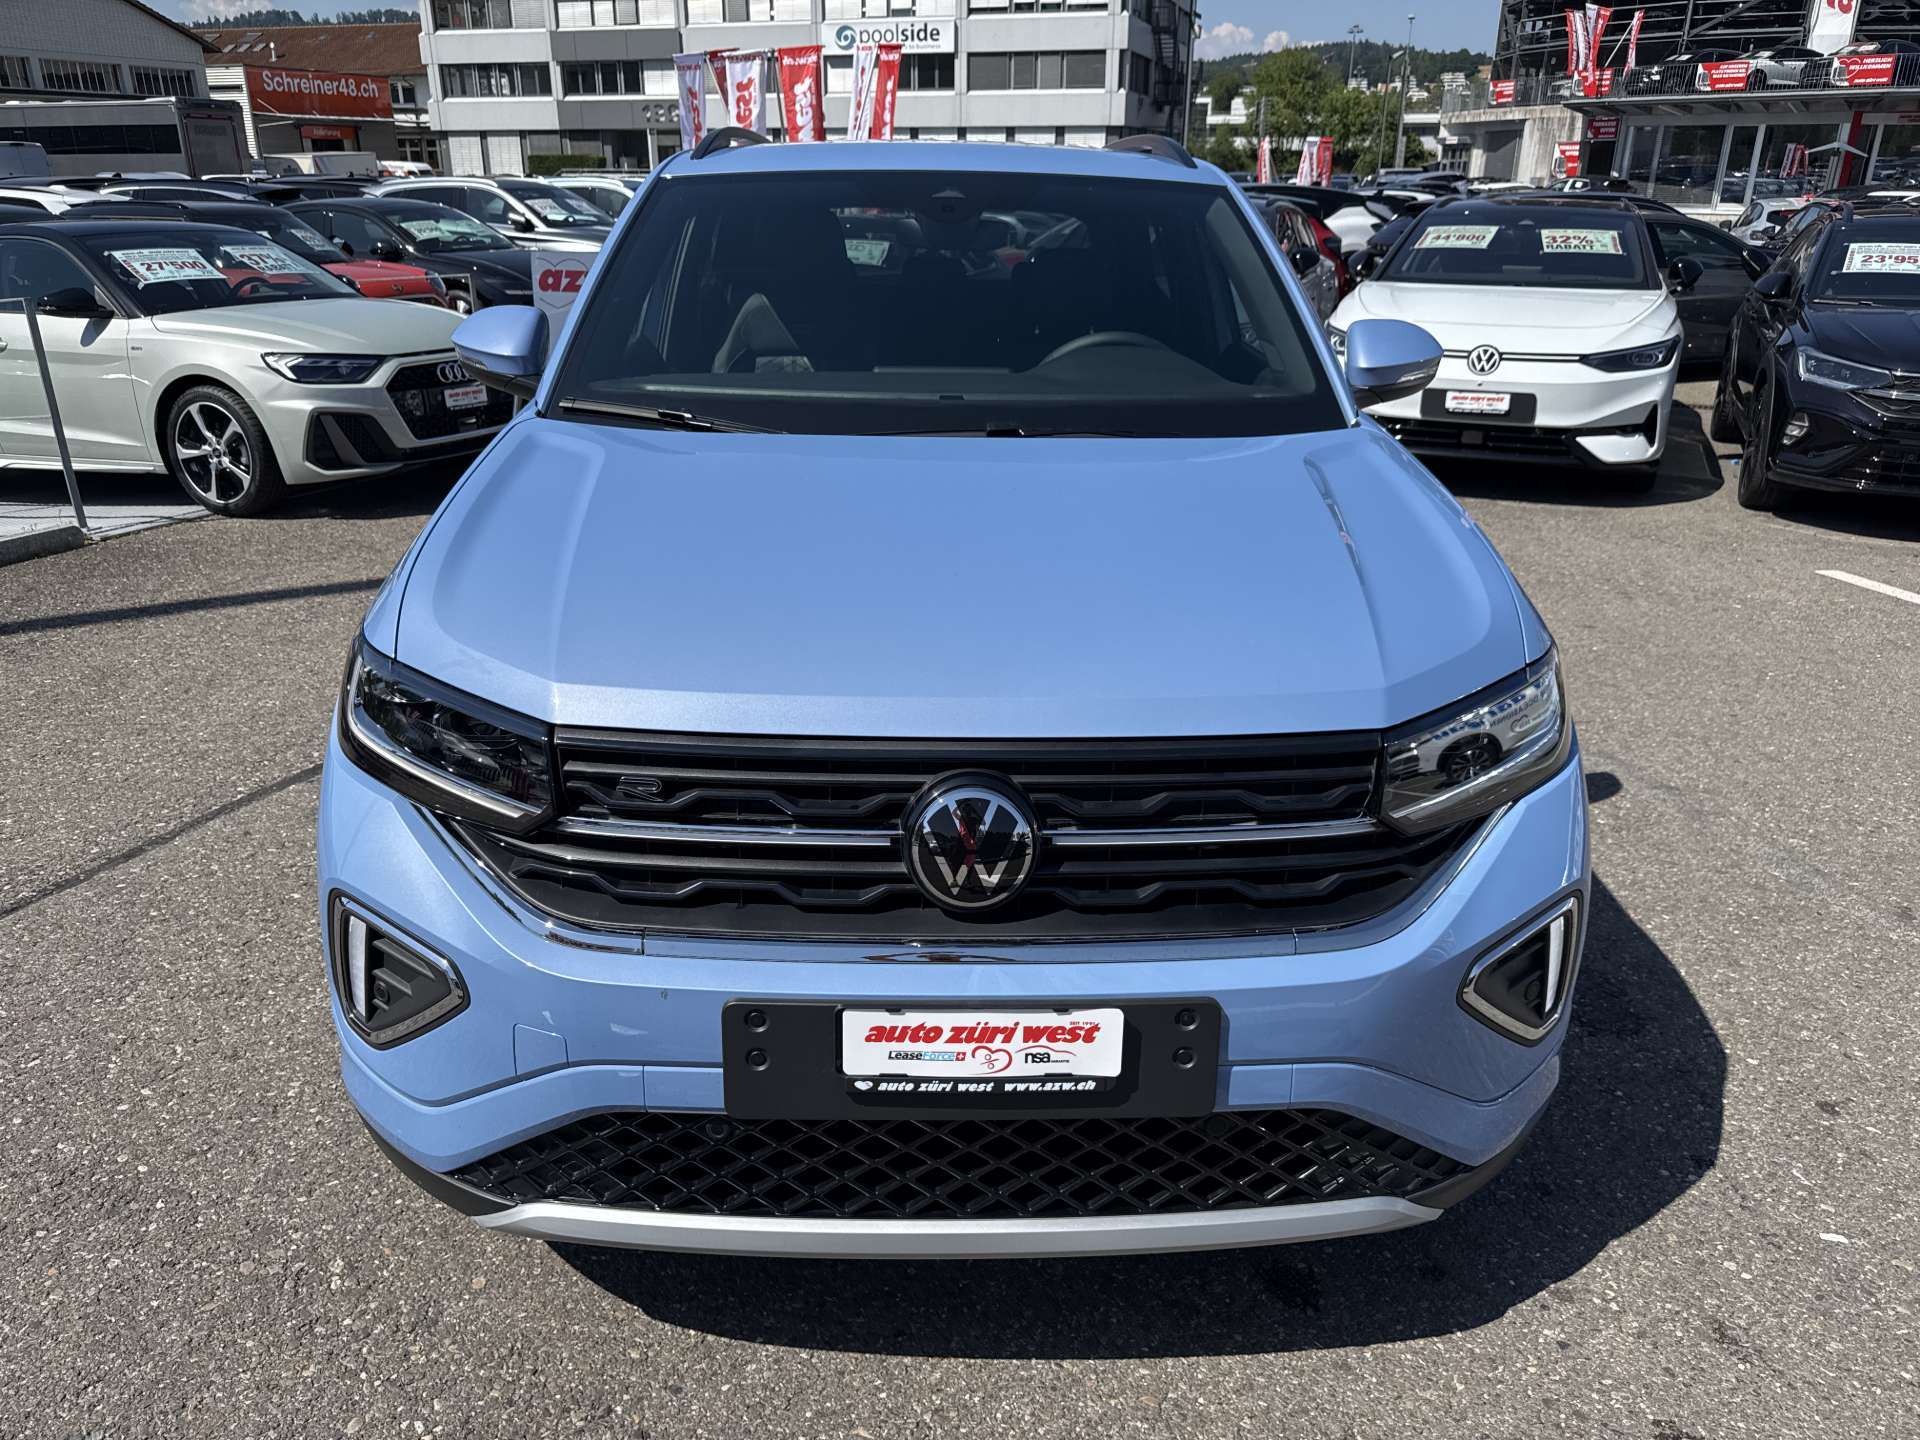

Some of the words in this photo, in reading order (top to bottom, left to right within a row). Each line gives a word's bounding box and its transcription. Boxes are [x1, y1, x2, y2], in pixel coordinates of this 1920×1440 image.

[859, 22, 940, 43] poolside
[262, 70, 379, 98] Schreiner48.ch
[1431, 233, 1487, 241] 44'800
[1545, 234, 1594, 245] 32%
[141, 260, 209, 273] 27'500
[864, 1022, 944, 1043] auto
[944, 1022, 1020, 1044] züri
[1022, 1023, 1102, 1044] west
[888, 1051, 956, 1061] LeaseForce
[1024, 1052, 1051, 1064] nsa
[877, 1080, 915, 1091] auto
[918, 1080, 954, 1092] züri
[957, 1081, 995, 1092] west
[1004, 1080, 1097, 1092] www.azw.ch
